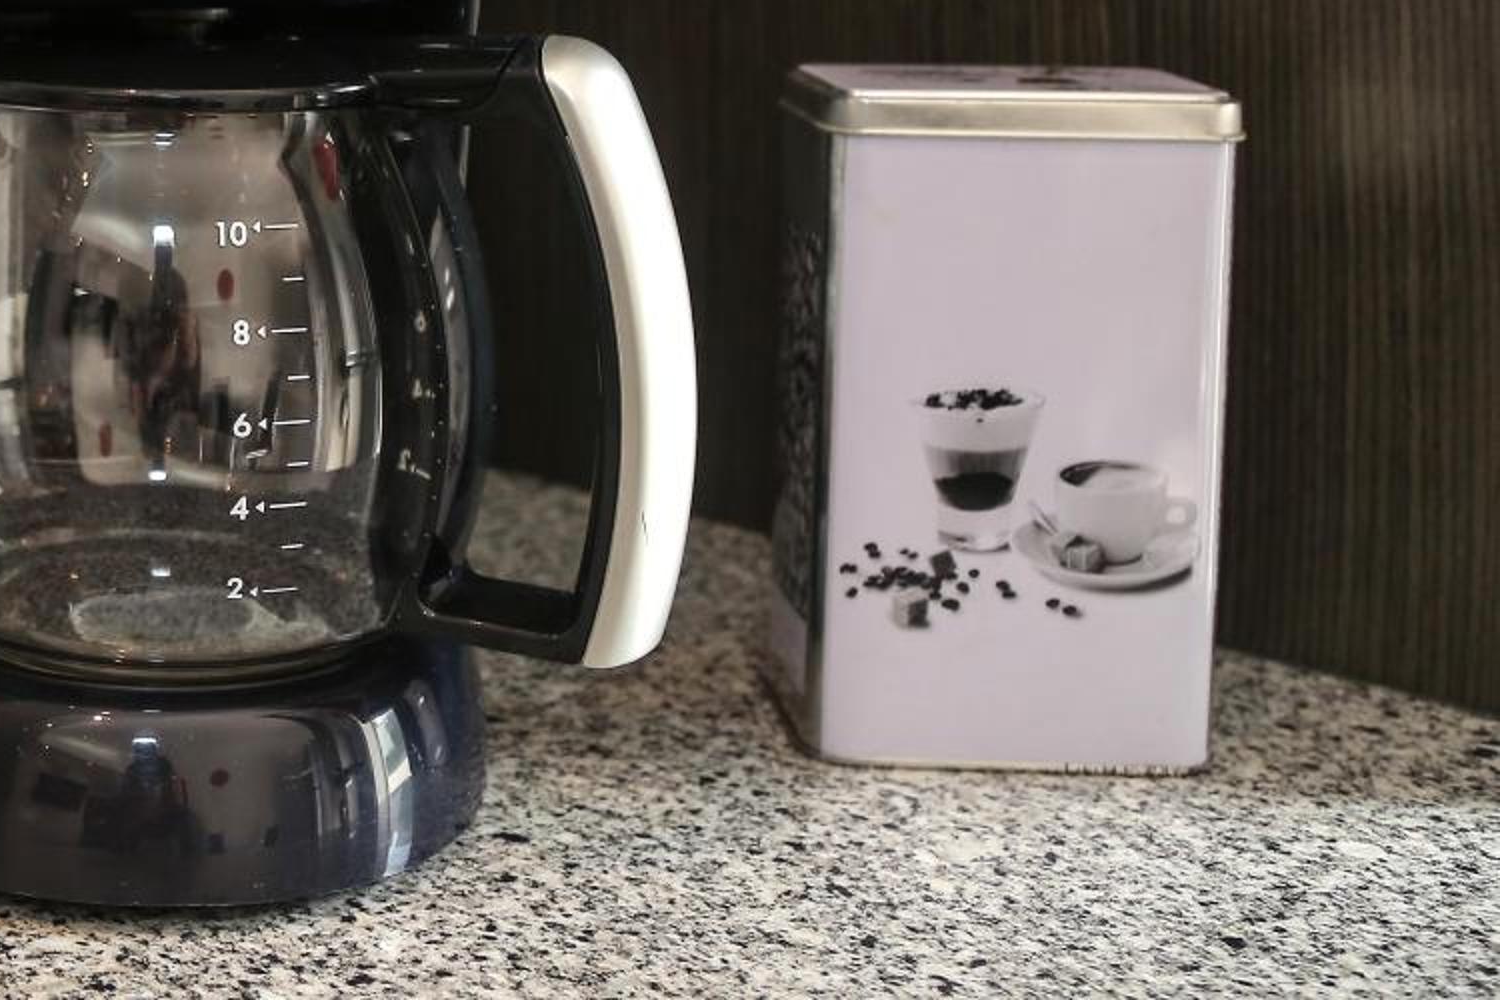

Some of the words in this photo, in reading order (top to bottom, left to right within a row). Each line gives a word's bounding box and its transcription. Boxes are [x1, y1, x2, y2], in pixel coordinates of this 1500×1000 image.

[214, 221, 248, 248] 10
[233, 319, 251, 346] 8
[233, 413, 252, 439] 6
[229, 496, 250, 521] 4
[227, 579, 244, 600] 2
